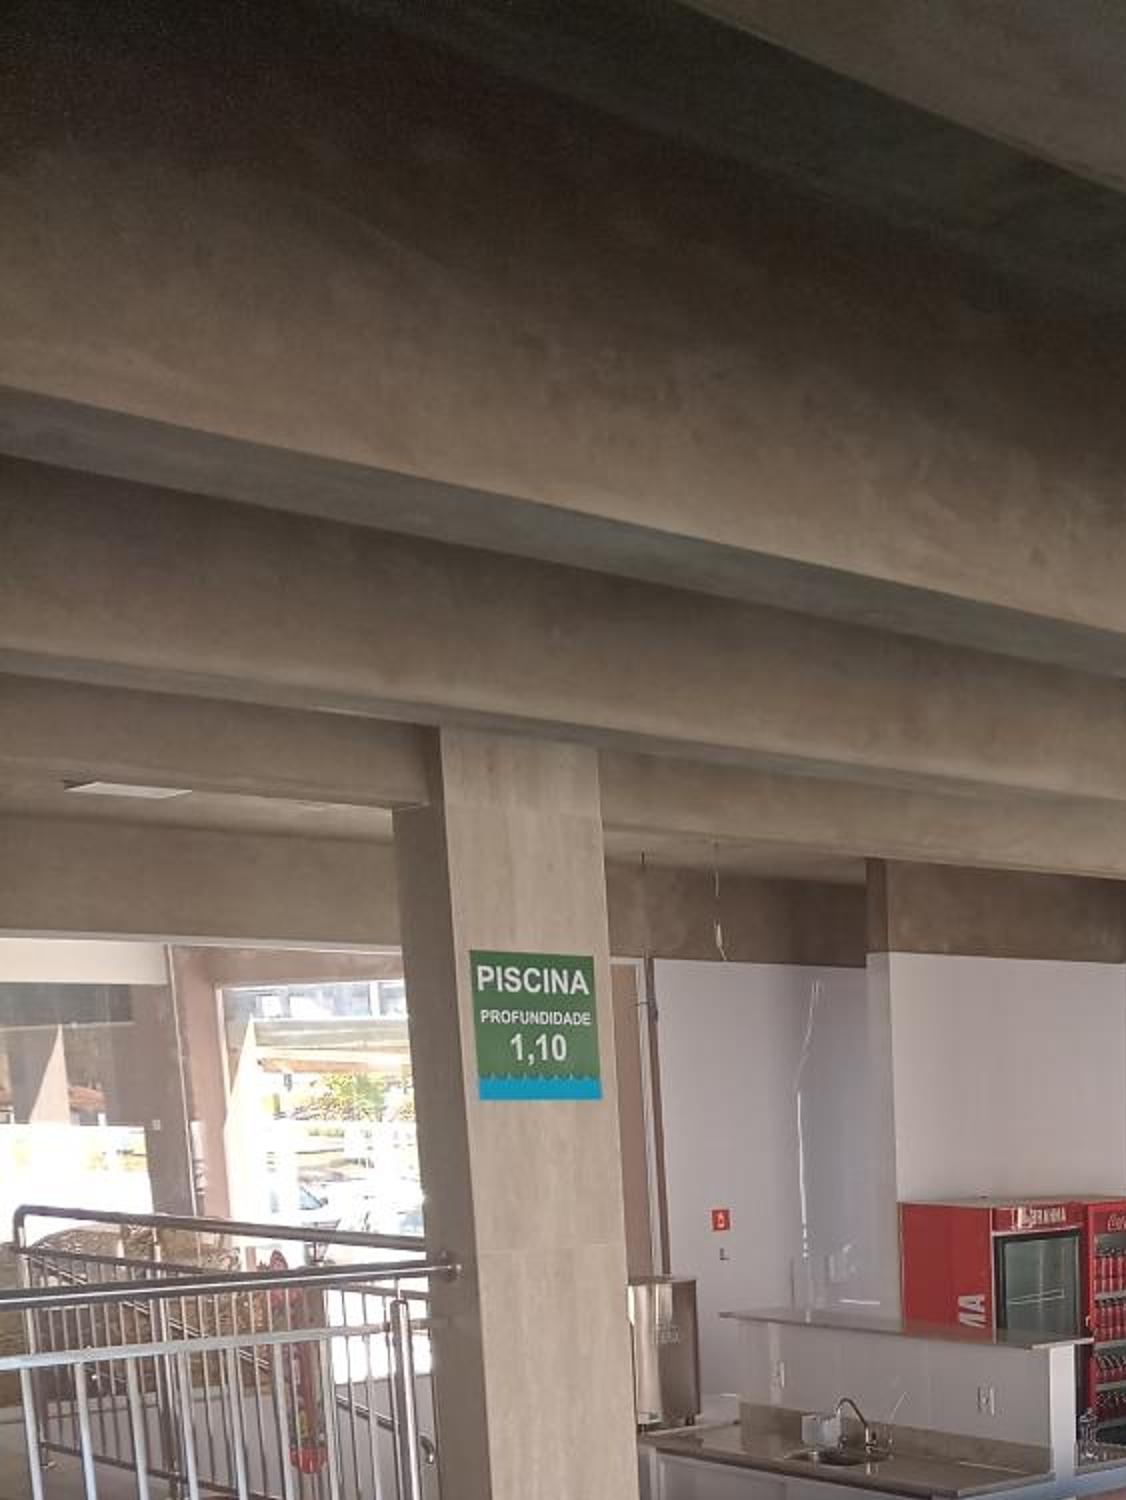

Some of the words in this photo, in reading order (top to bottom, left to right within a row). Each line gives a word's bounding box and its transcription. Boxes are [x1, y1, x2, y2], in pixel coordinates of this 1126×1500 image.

[477, 965, 590, 995] PISCINA
[480, 1009, 592, 1026] PROFUNDIDADE
[510, 1033, 567, 1066] 1,10
